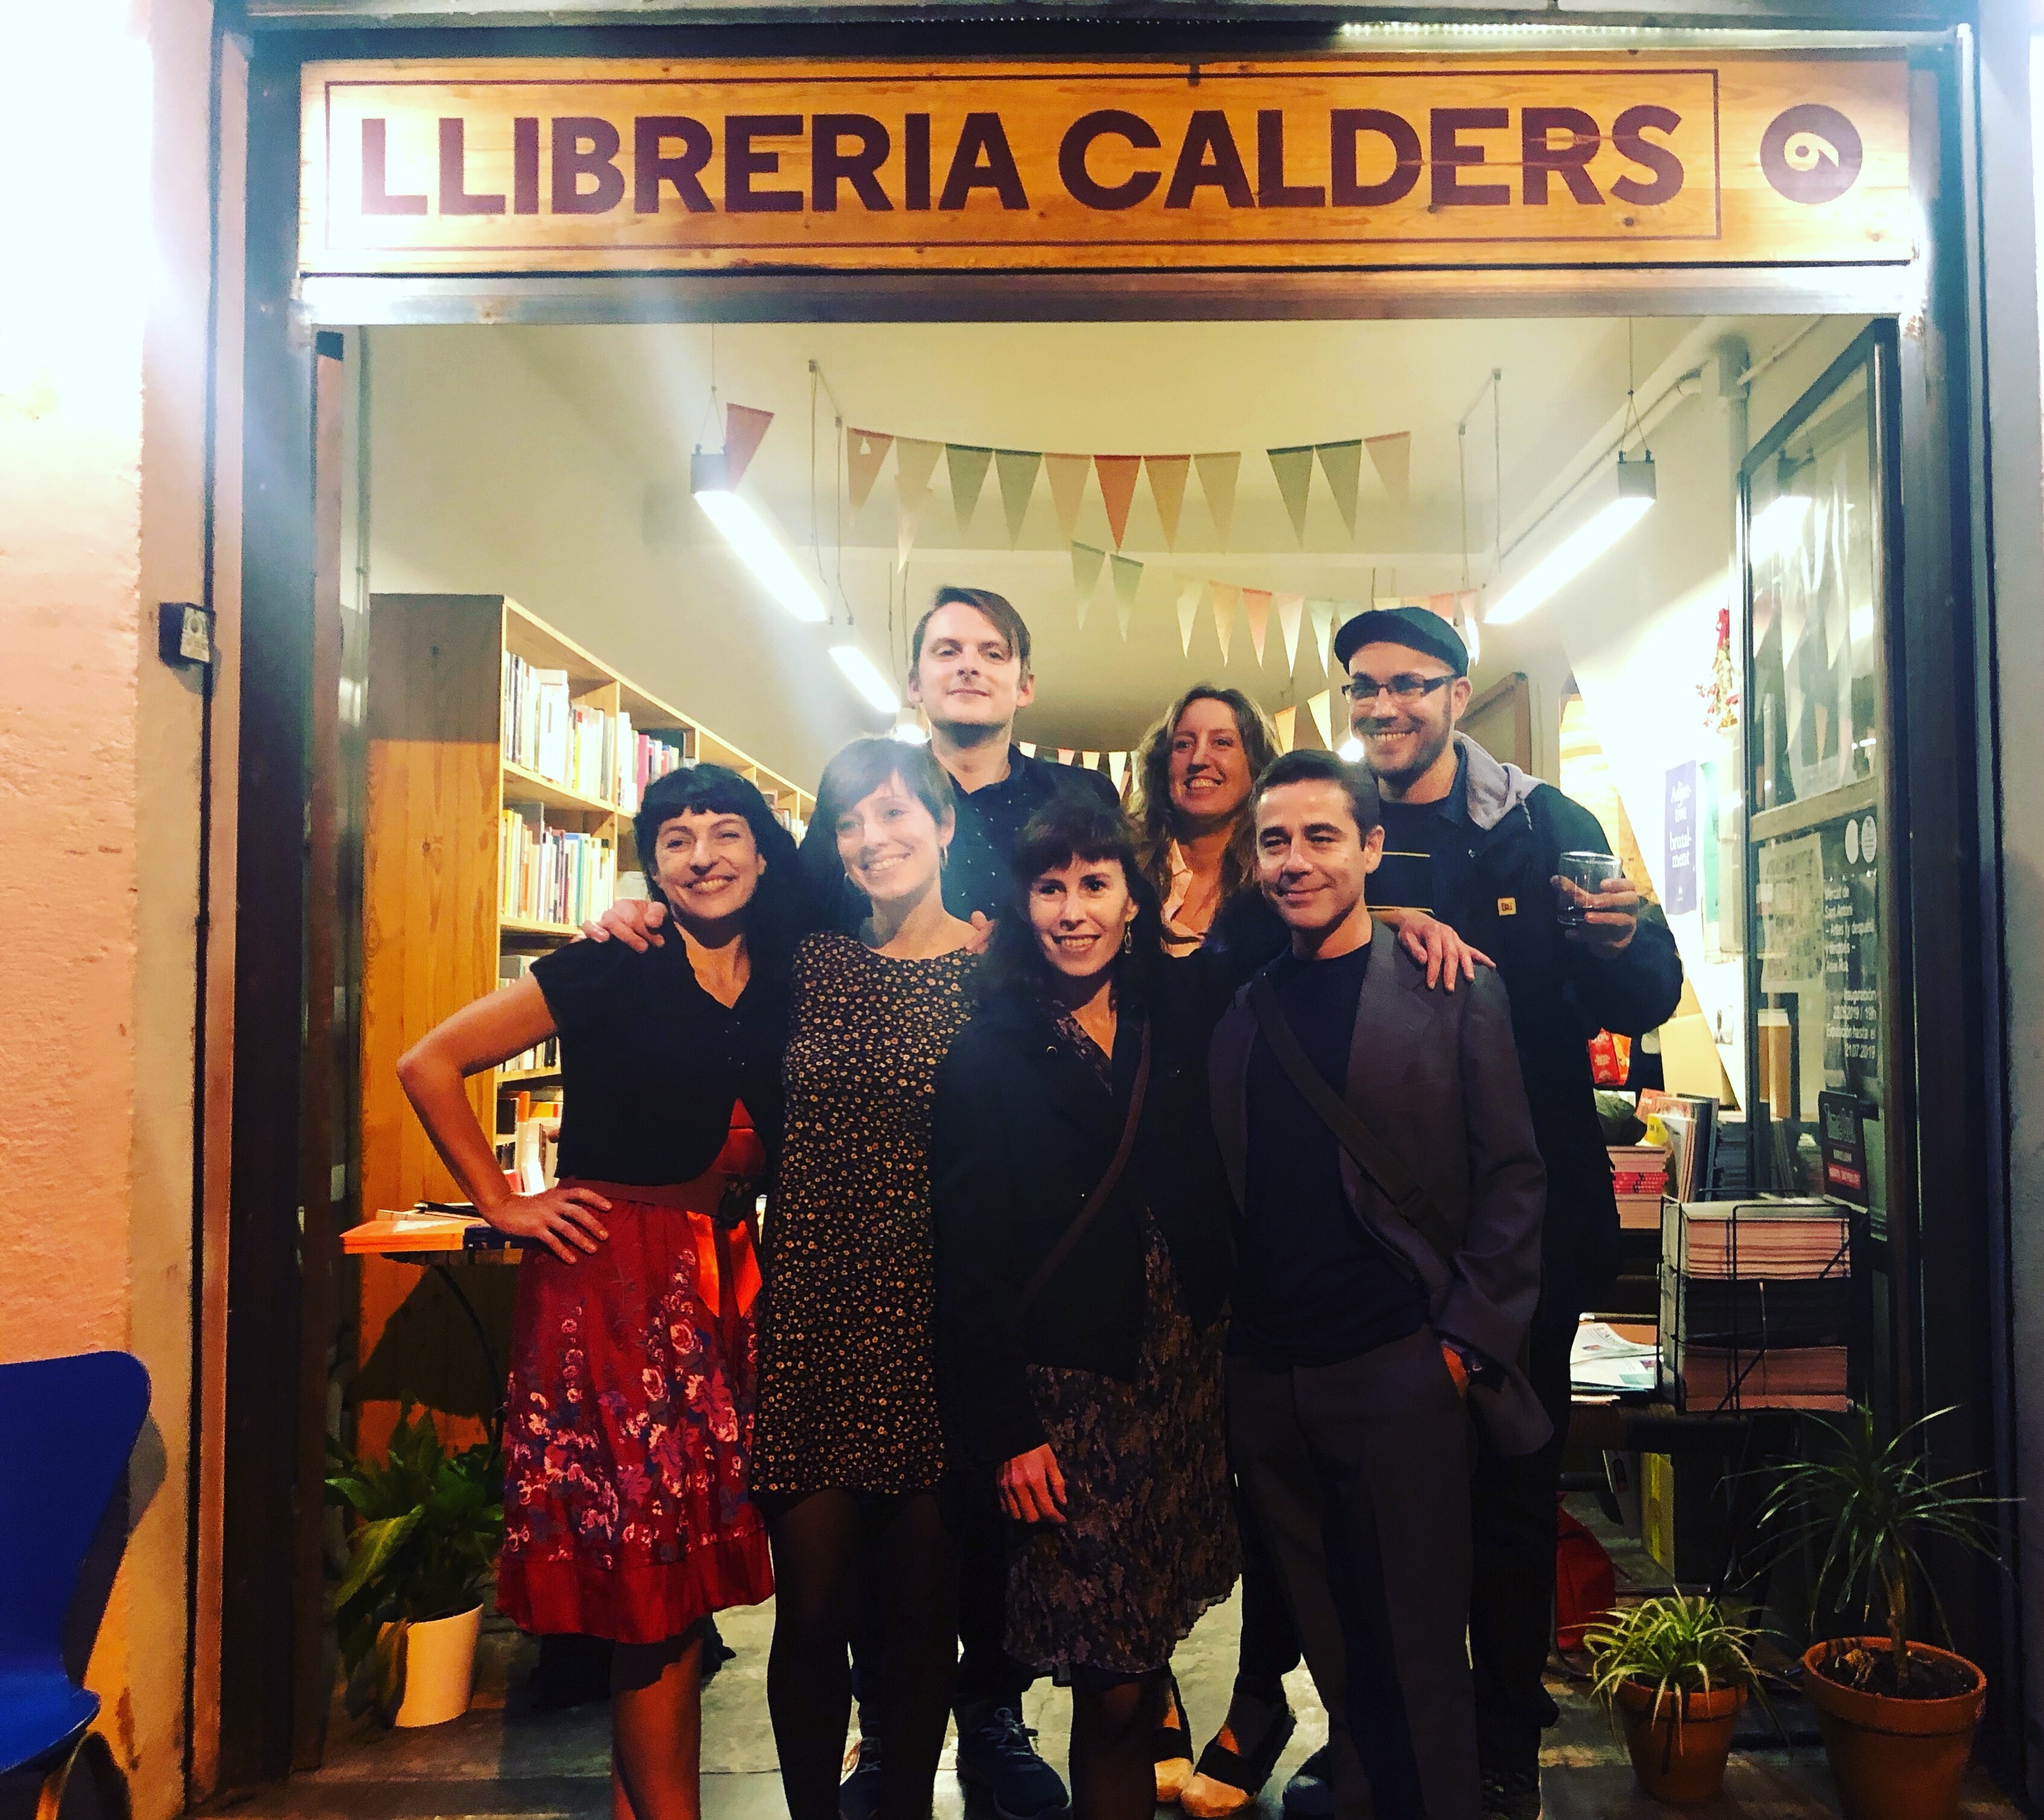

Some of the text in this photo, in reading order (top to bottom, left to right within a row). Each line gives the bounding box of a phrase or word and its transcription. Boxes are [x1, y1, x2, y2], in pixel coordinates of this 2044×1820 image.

[361, 104, 1685, 216] LLIBRERIA CALDERS
[1672, 850, 1690, 869] ment
